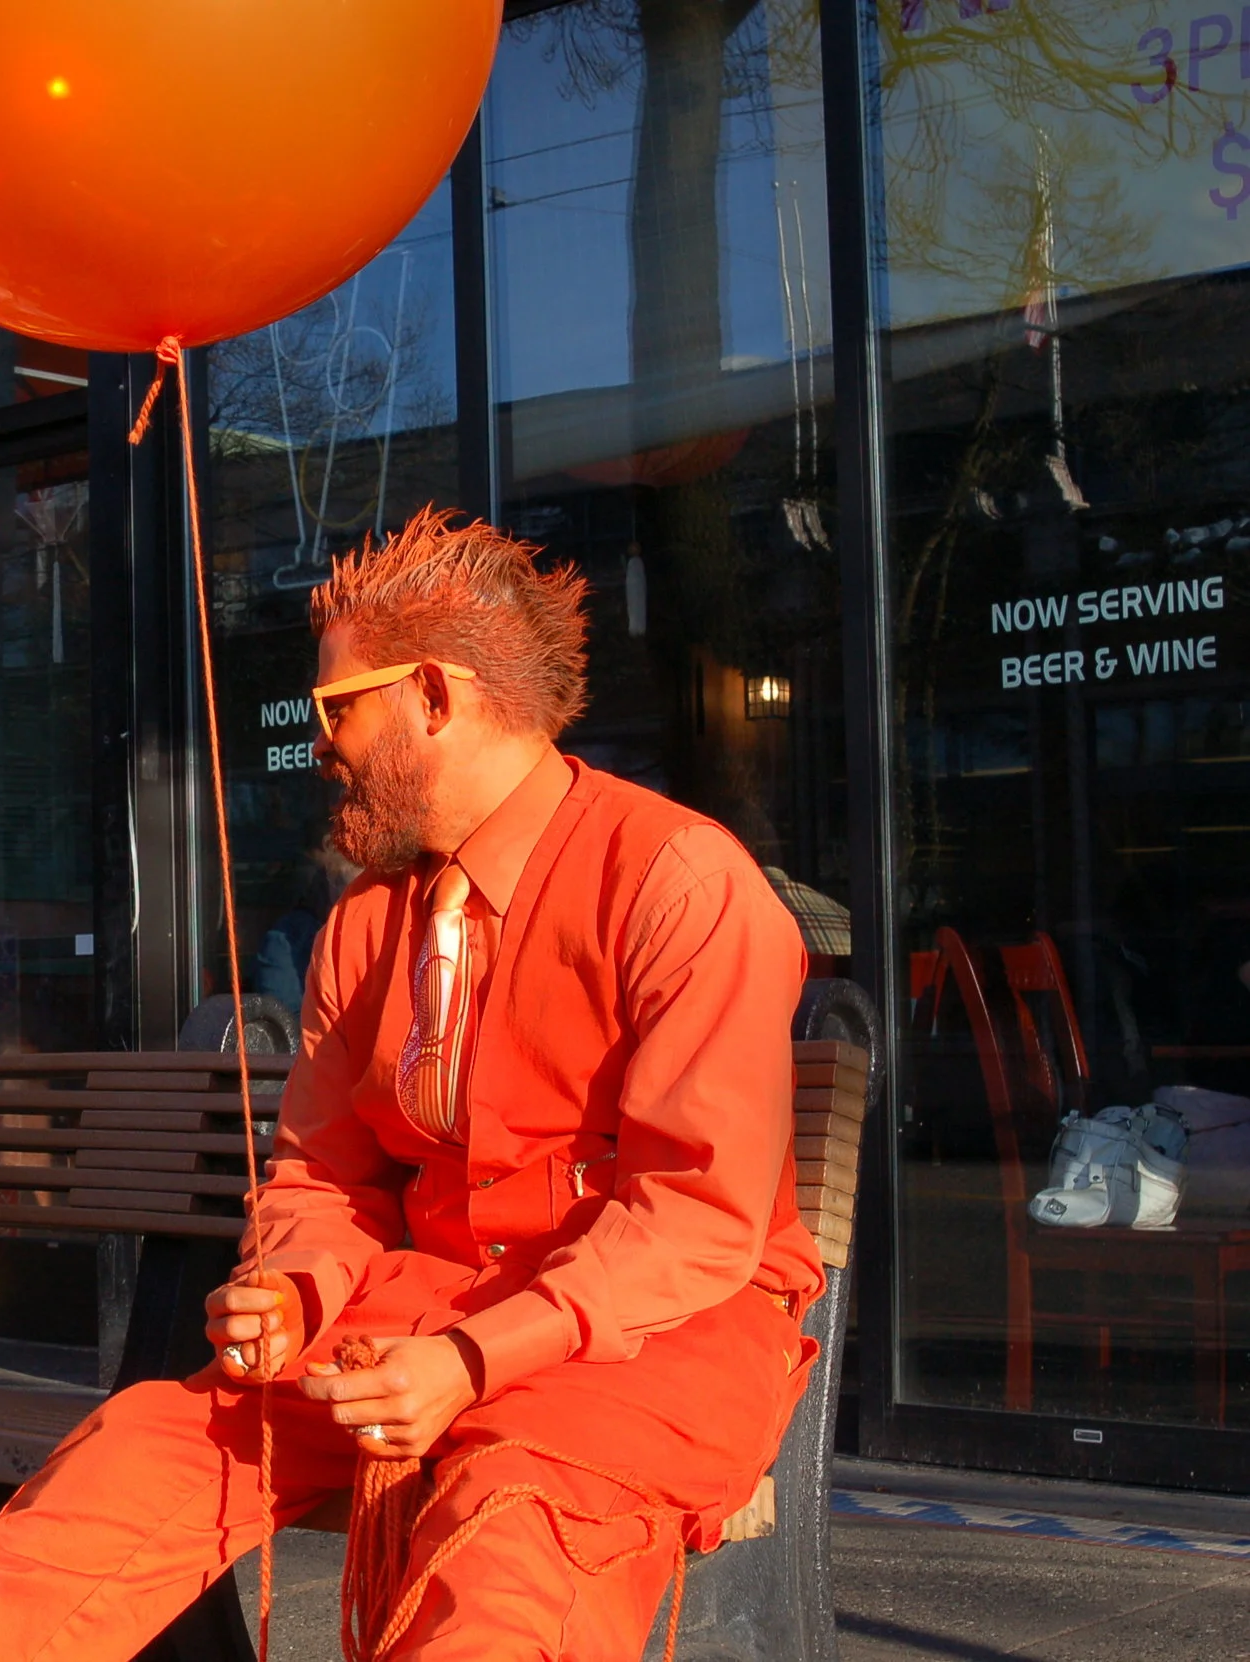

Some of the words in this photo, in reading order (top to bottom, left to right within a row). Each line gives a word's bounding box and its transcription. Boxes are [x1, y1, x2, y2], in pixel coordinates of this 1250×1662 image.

[1131, 5, 1250, 104] 3P
[991, 594, 1069, 634] NOW
[1077, 576, 1224, 625] SERVING
[1002, 650, 1086, 689] BEER
[1095, 647, 1118, 680] &
[1126, 635, 1217, 676] WINE
[261, 697, 312, 728] NOW
